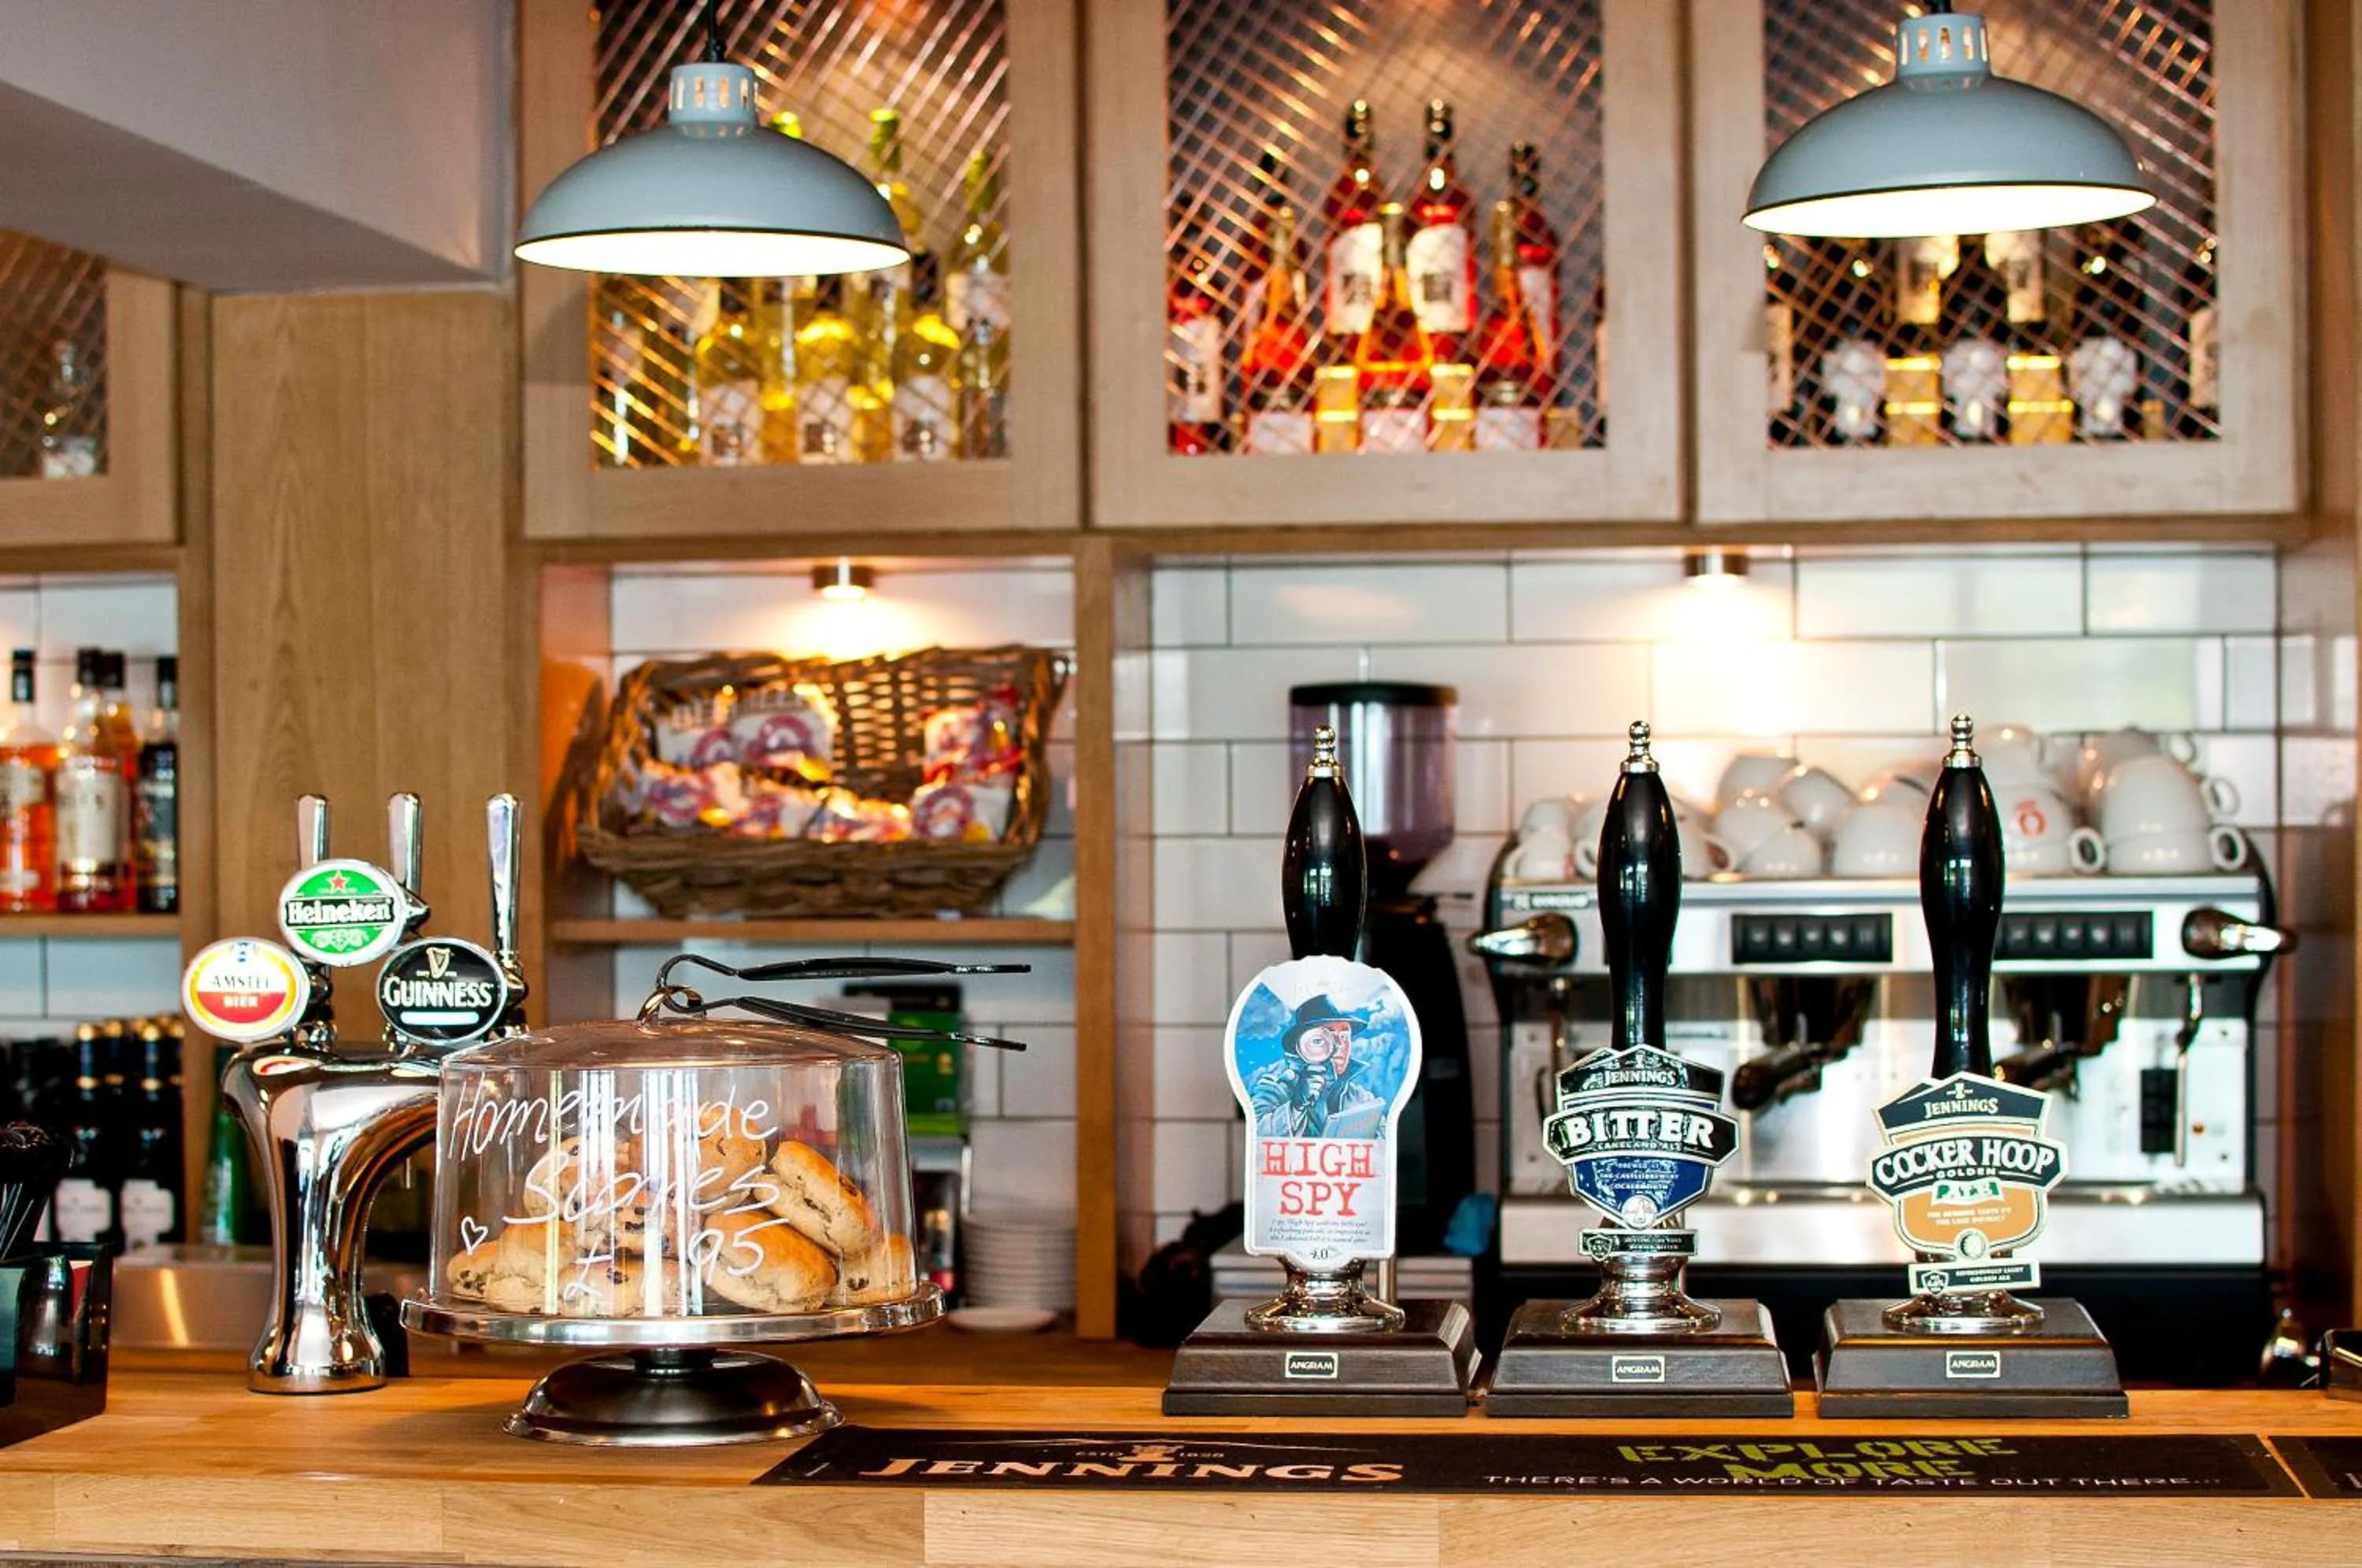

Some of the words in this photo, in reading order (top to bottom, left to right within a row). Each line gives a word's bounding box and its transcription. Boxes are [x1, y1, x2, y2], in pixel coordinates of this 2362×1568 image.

[287, 899, 392, 923] Heineken
[223, 995, 258, 1008] BIER
[383, 975, 494, 1008] GUINNESS
[1605, 1070, 1676, 1085] JENNINGS
[1923, 1098, 1998, 1119] JENNINGS
[1564, 1110, 1714, 1148] BITTER
[1261, 1141, 1376, 1178] HIGH
[1875, 1138, 1975, 1185] COCKER
[1982, 1139, 2055, 1175] HOOP
[1937, 1167, 1996, 1178] GOLDEN
[1279, 1181, 1361, 1216] SPY
[1290, 1361, 1333, 1370] ANGRAM
[1616, 1438, 2018, 1463] EXPLORE
[858, 1459, 1404, 1481] JENNINGS
[1483, 1476, 1630, 1485] THERE'S
[1640, 1476, 1663, 1485] A
[1672, 1477, 1802, 1486] WORLD
[1813, 1477, 1860, 1486] OF
[1868, 1477, 1979, 1486] TASTE
[1990, 1477, 2059, 1486] OUT
[1722, 1460, 1975, 1480] MORE
